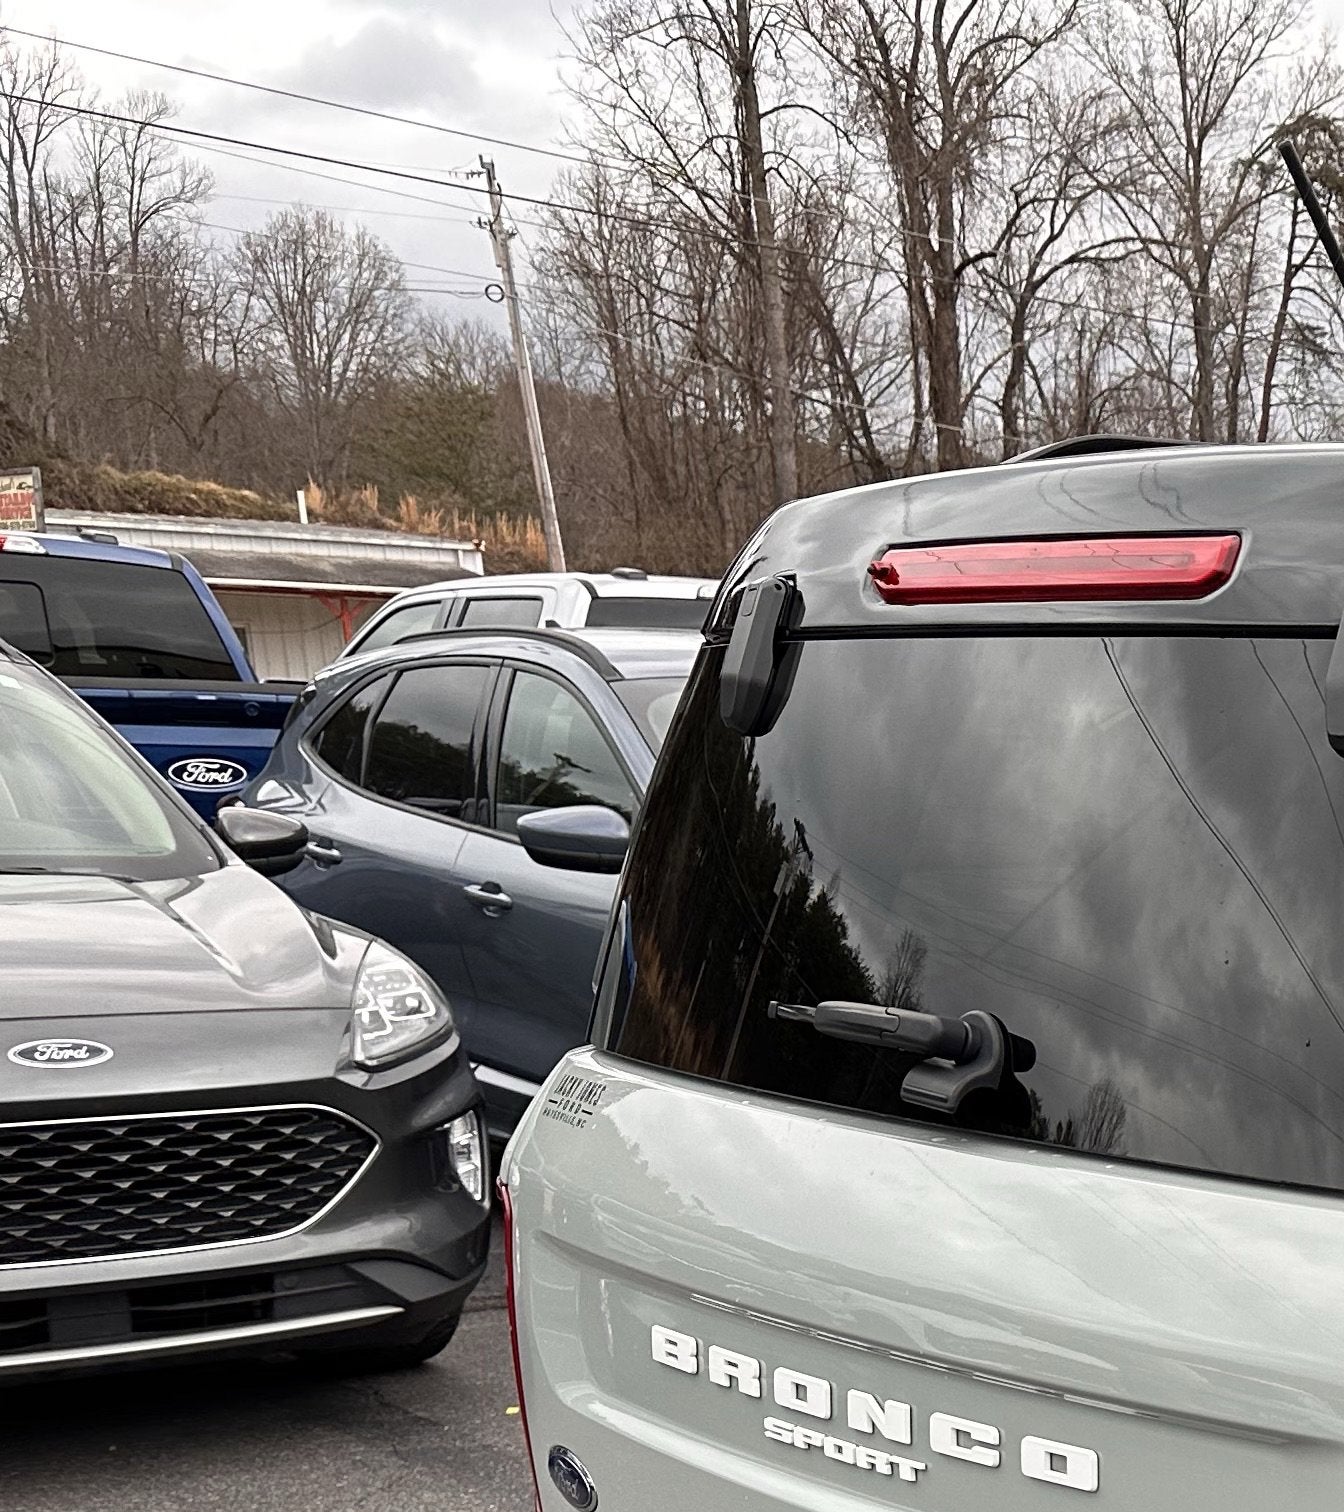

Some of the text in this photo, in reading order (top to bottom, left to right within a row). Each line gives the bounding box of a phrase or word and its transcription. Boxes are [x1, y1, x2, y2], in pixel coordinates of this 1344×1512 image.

[182, 762, 233, 783] Ford
[33, 1043, 90, 1061] Ford
[557, 1098, 582, 1115] FORD
[651, 1324, 1099, 1493] BRONCO
[763, 1415, 927, 1483] SPORT
